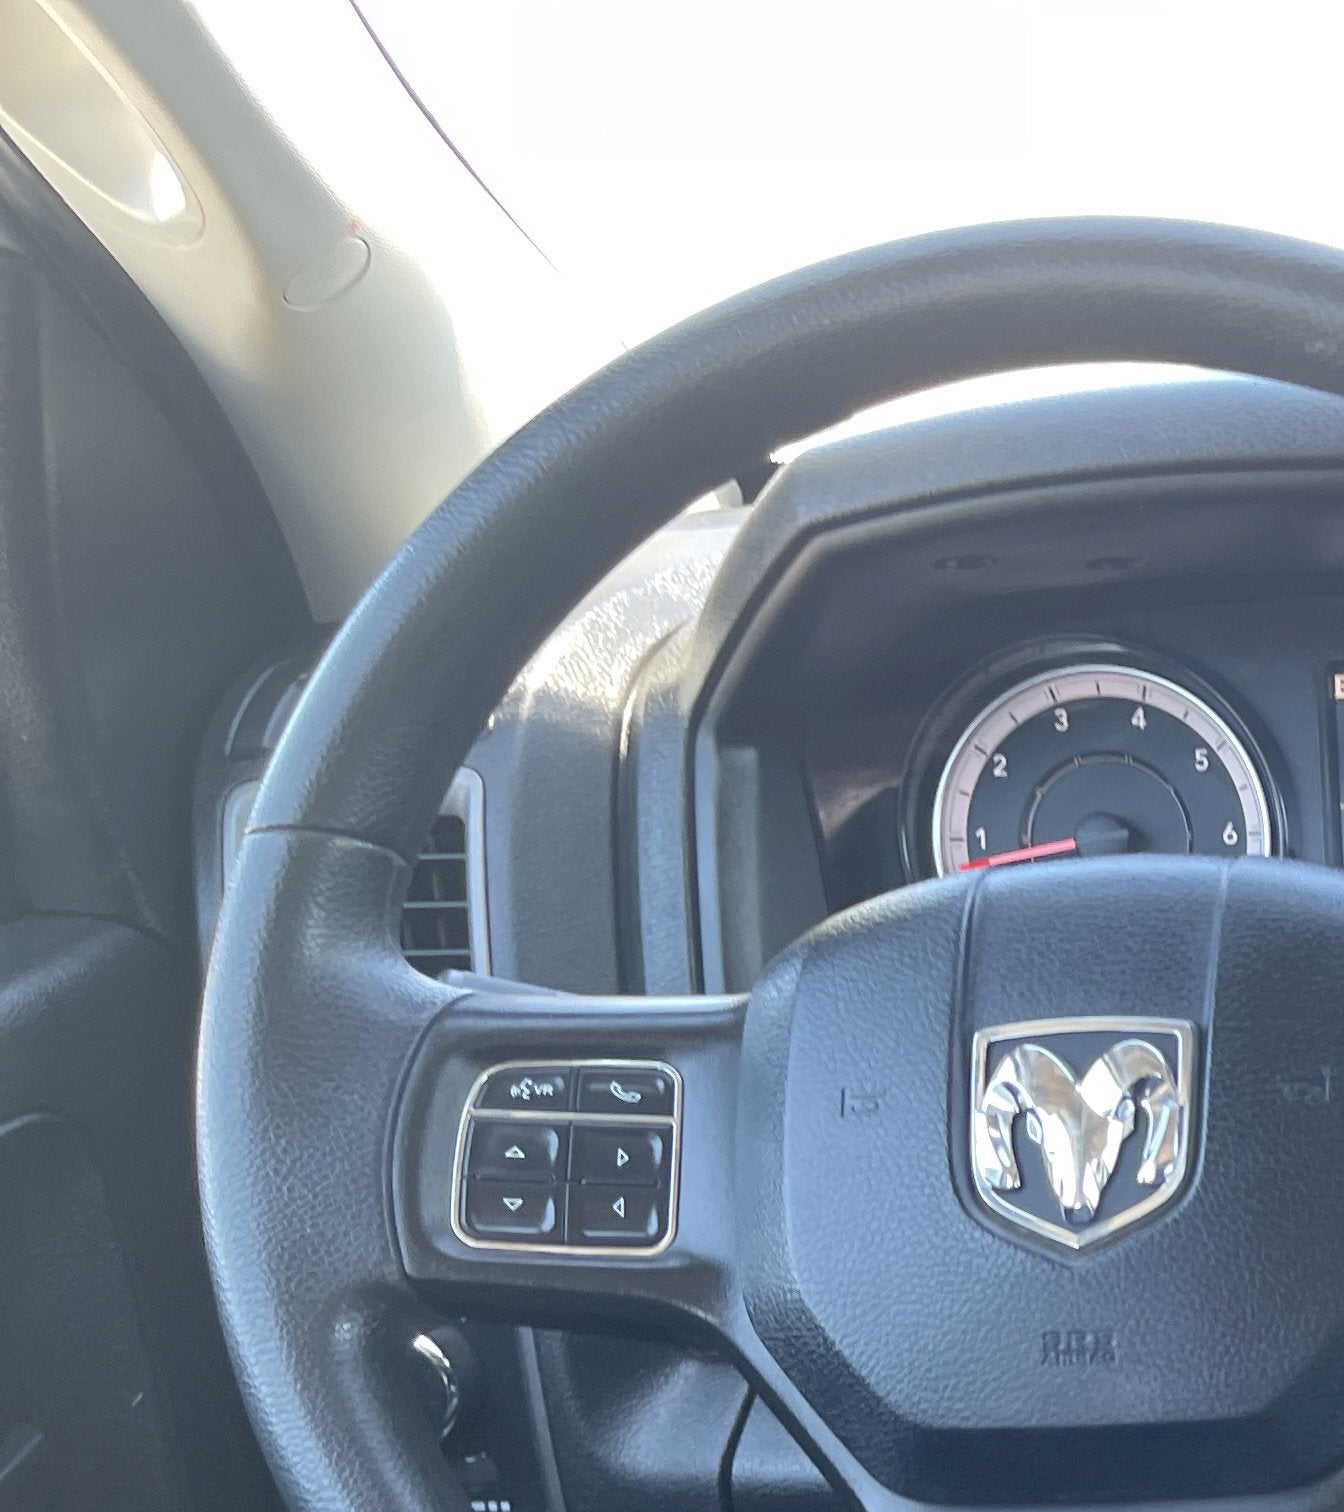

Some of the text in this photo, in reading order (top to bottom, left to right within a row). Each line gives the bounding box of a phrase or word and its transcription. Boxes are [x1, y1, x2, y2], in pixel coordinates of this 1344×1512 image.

[1053, 707, 1069, 732] 3
[1130, 706, 1147, 731] 4
[992, 753, 1008, 778] 2
[1194, 748, 1209, 772] 5
[975, 827, 987, 850] 1
[1222, 821, 1238, 846] 6
